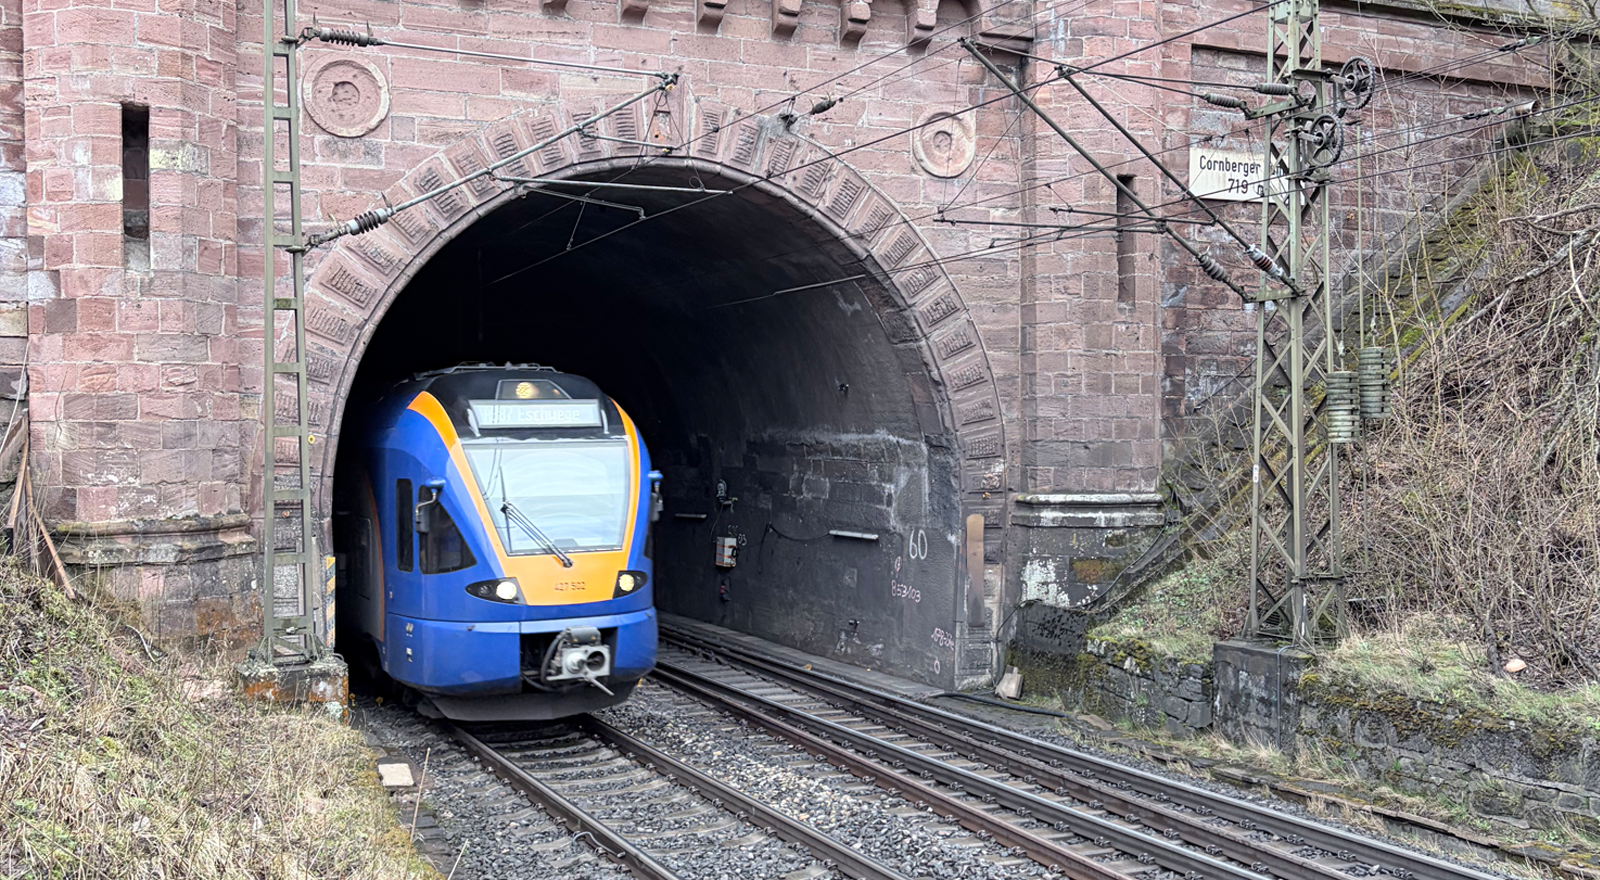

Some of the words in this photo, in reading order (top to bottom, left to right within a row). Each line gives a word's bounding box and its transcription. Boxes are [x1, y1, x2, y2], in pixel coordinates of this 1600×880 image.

[1199, 155, 1261, 178] Cornberger
[1227, 178, 1249, 194] 719
[518, 407, 581, 422] Eschwege
[909, 528, 928, 560] 60
